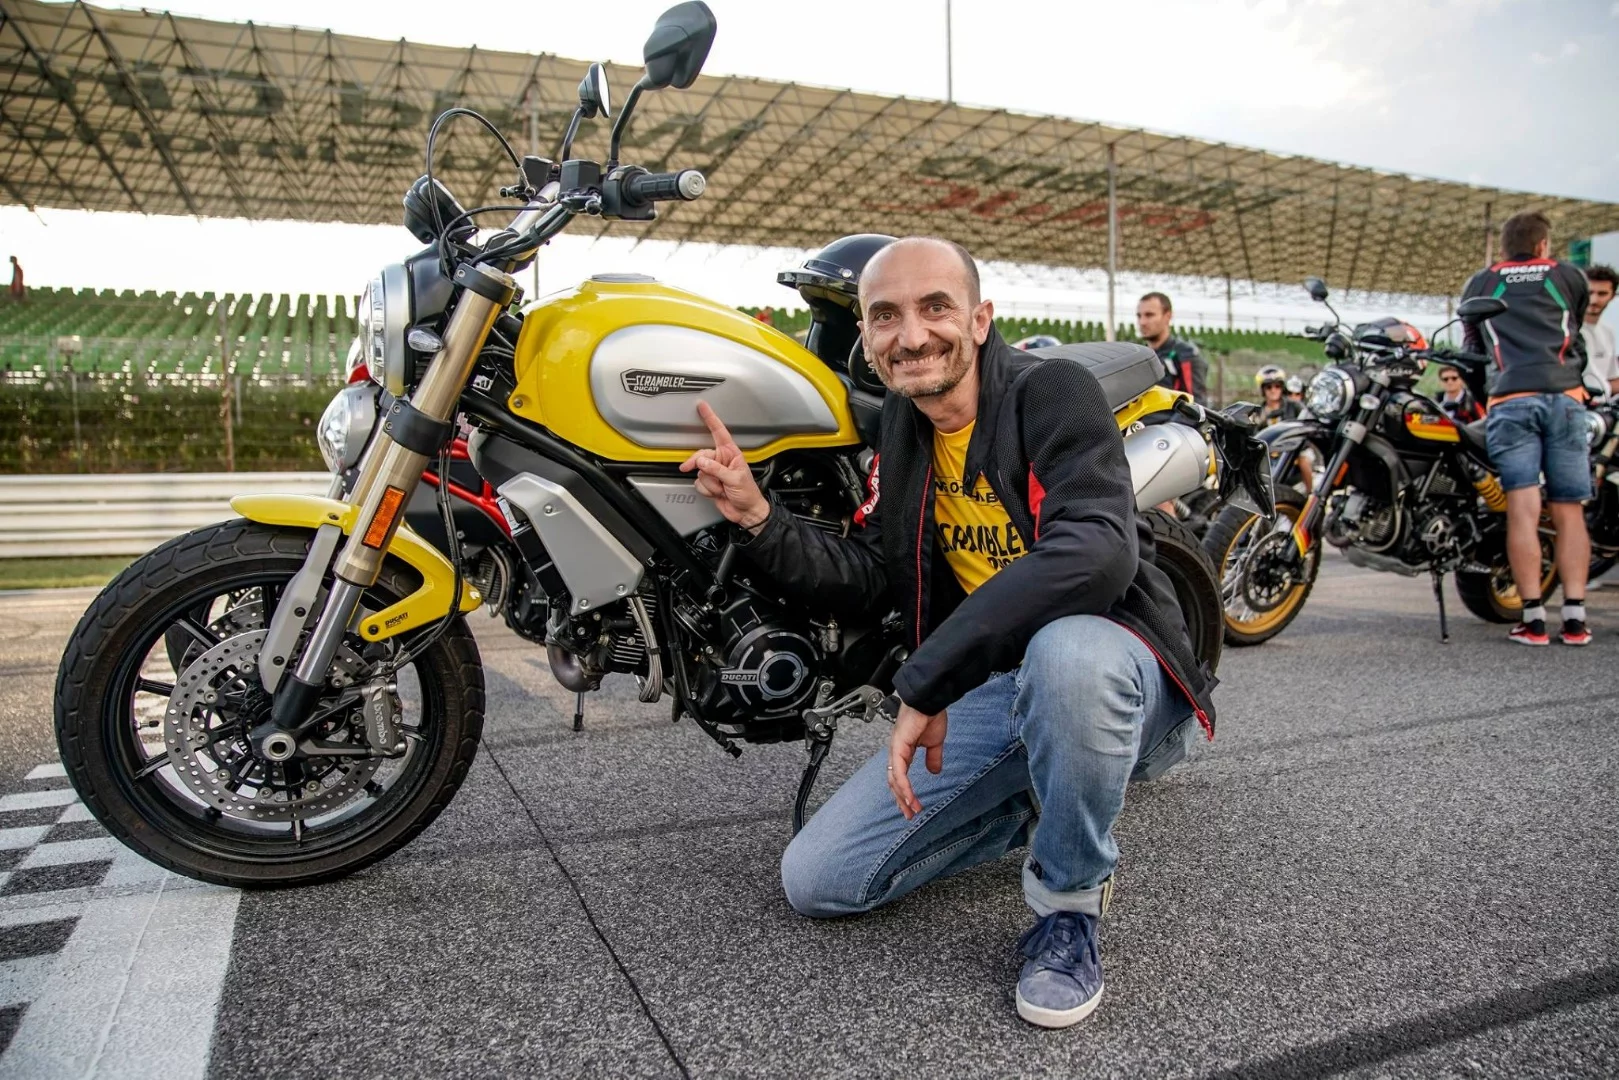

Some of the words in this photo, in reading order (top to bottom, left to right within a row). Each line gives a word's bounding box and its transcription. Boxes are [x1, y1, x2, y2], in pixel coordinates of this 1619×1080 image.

[1500, 265, 1550, 275] DUCATI
[1505, 272, 1544, 283] CORSE
[635, 375, 685, 388] SCRAMBLER
[665, 493, 697, 504] 1100
[384, 611, 409, 627] DUCATI
[373, 702, 388, 745] brembo
